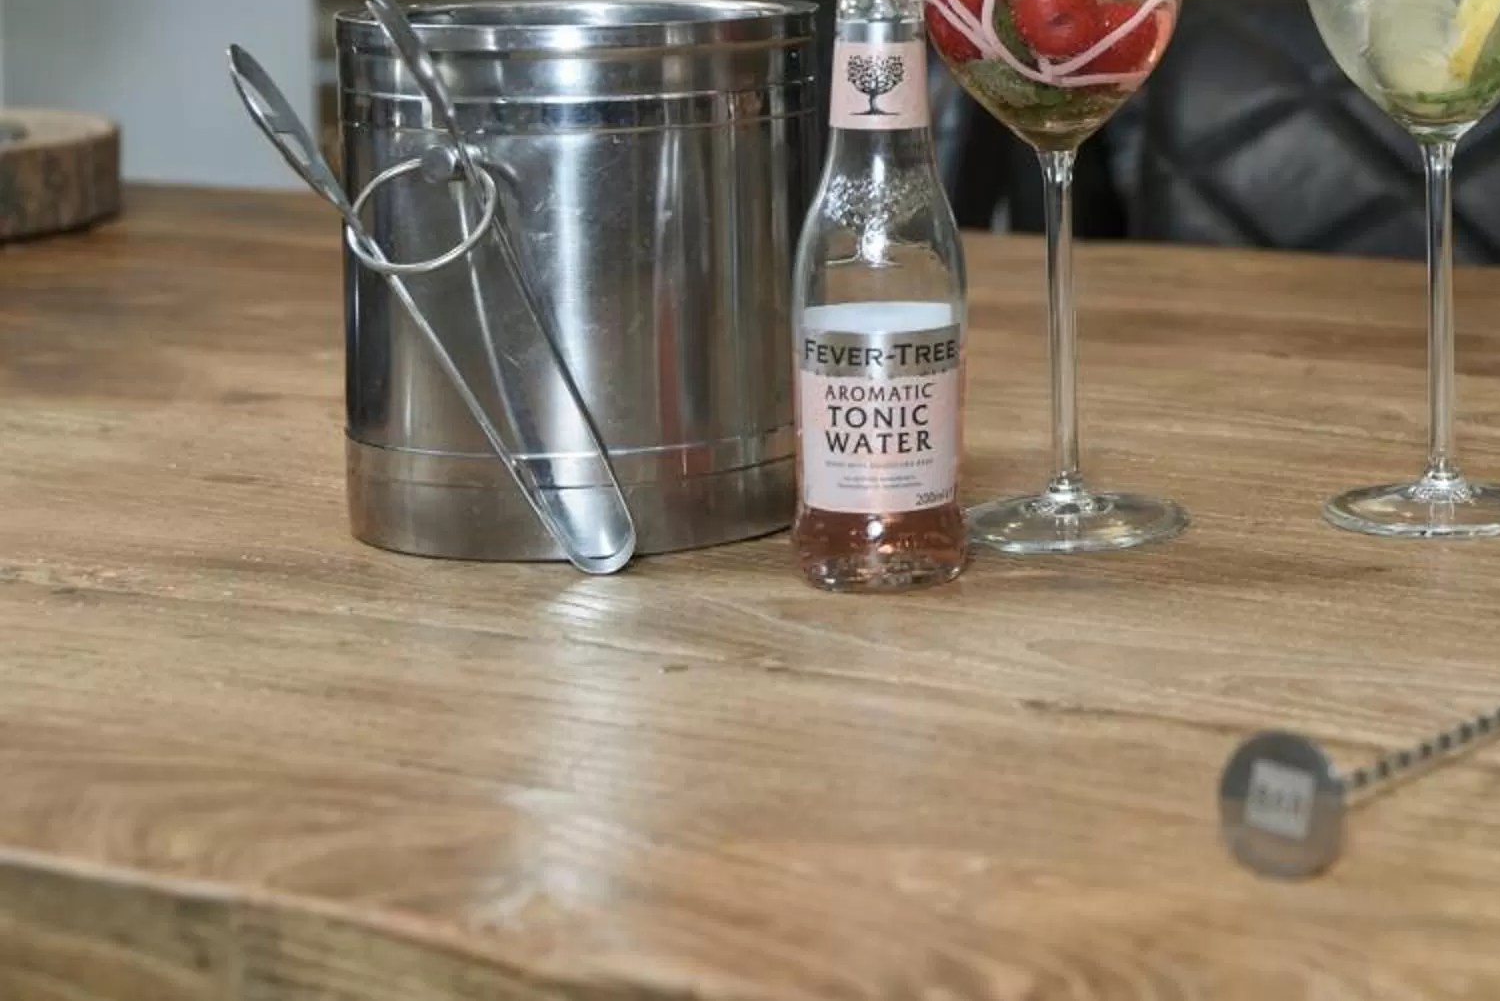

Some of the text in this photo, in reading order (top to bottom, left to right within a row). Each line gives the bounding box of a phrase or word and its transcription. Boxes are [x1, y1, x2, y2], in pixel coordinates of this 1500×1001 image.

[804, 338, 957, 367] FEVER-TREE
[824, 382, 938, 403] AROMATIC
[827, 404, 929, 429] TONIC
[824, 430, 933, 455] WATER
